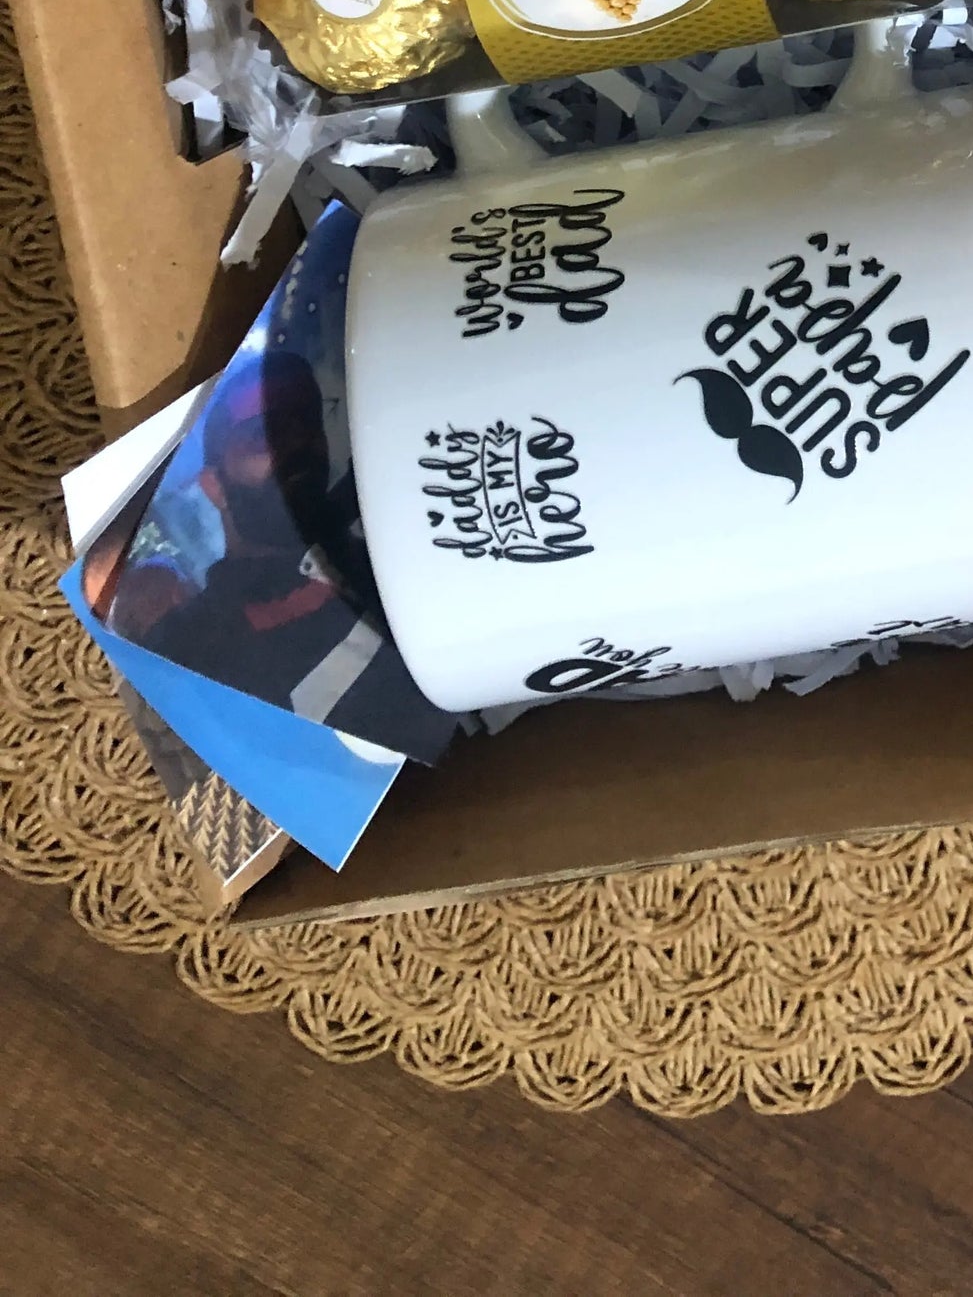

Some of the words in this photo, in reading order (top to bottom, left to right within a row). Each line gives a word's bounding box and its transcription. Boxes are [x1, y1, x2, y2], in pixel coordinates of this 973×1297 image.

[503, 189, 625, 323] dad
[510, 219, 546, 282] BEST
[704, 288, 881, 478] SUPER
[764, 256, 971, 431] papa
[418, 423, 493, 558] daddy
[487, 451, 515, 489] MY
[494, 501, 523, 527] IS
[504, 417, 595, 563] hero
